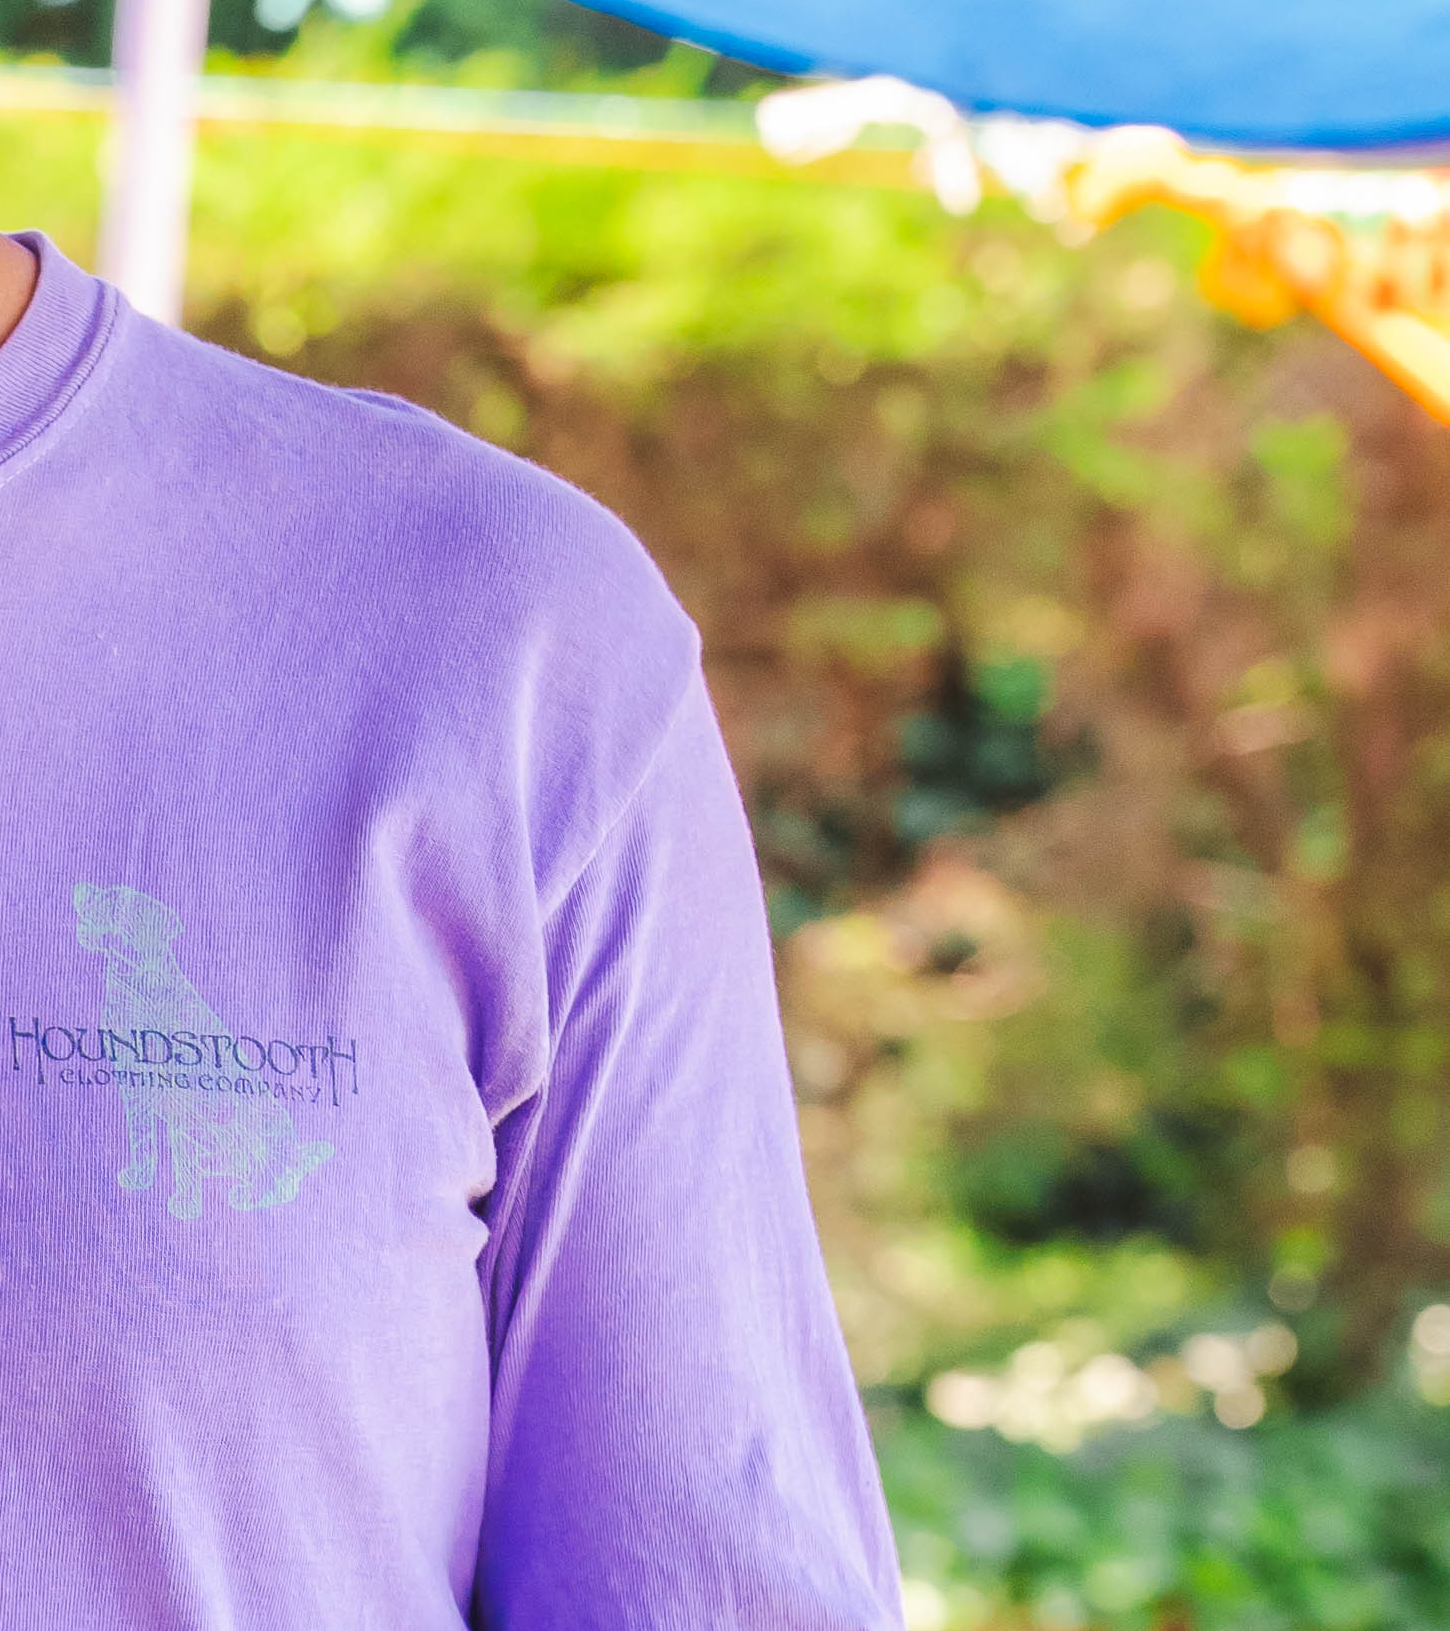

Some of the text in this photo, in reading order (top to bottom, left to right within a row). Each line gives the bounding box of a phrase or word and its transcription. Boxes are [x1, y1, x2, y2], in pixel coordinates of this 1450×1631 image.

[9, 1016, 359, 1107] HOUNDSTOOTH
[60, 1067, 322, 1104] CLOTHING COMPANY
